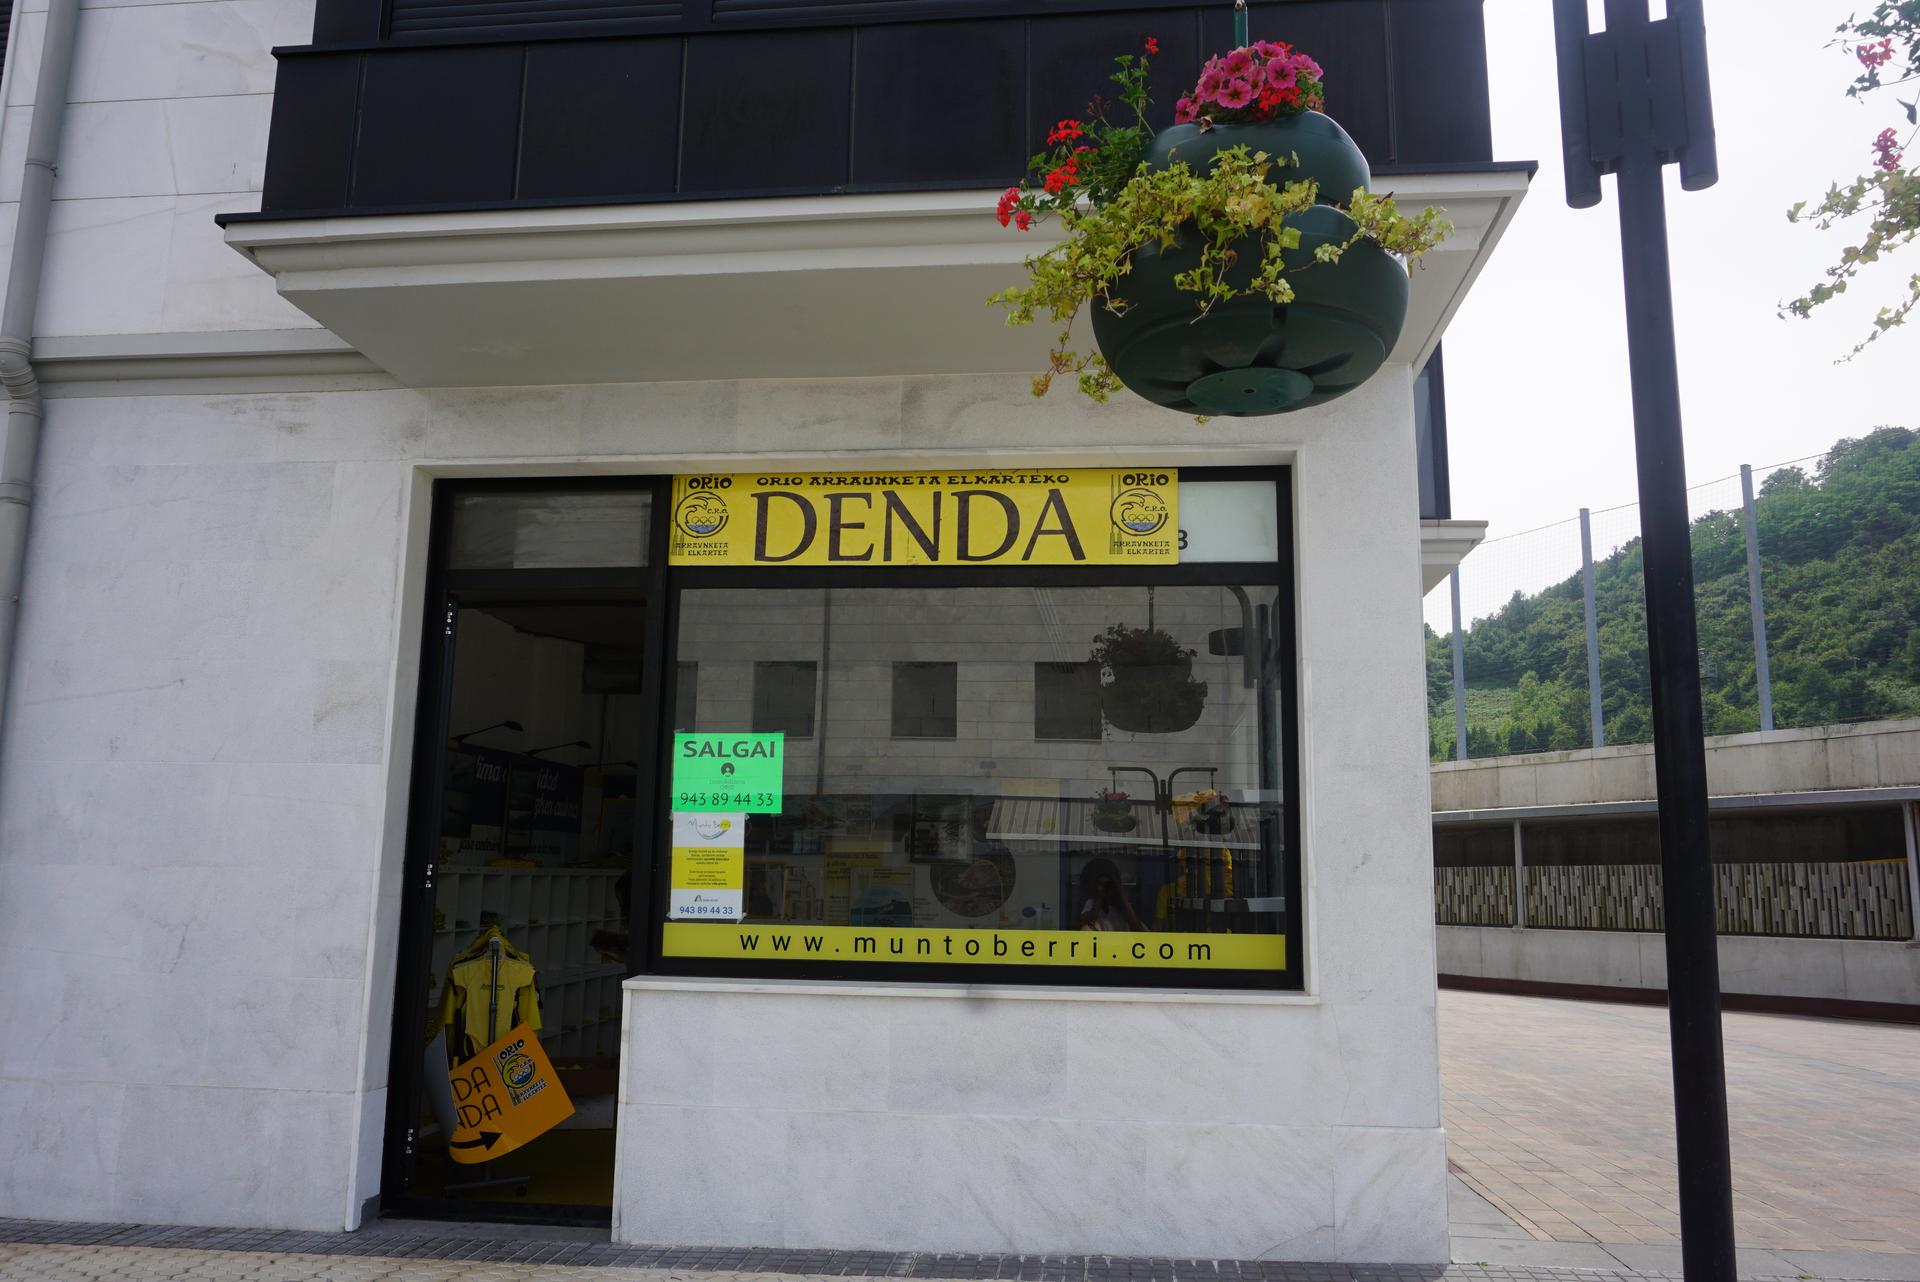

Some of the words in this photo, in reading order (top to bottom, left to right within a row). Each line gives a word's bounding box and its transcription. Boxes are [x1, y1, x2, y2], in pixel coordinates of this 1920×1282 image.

[809, 475, 941, 486] ARRAUNKETA
[947, 474, 1070, 485] ELKARTEKO
[750, 488, 1087, 562] DENDA
[683, 740, 775, 759] SALGAI
[680, 792, 706, 807] 943
[711, 792, 729, 807] 89
[733, 792, 751, 807] 44
[757, 792, 774, 808] 33
[679, 906, 695, 915] 943
[697, 906, 708, 915] 89
[709, 906, 721, 915] 44
[722, 906, 733, 915] 33
[740, 934, 1211, 961] www.muntoberri.com
